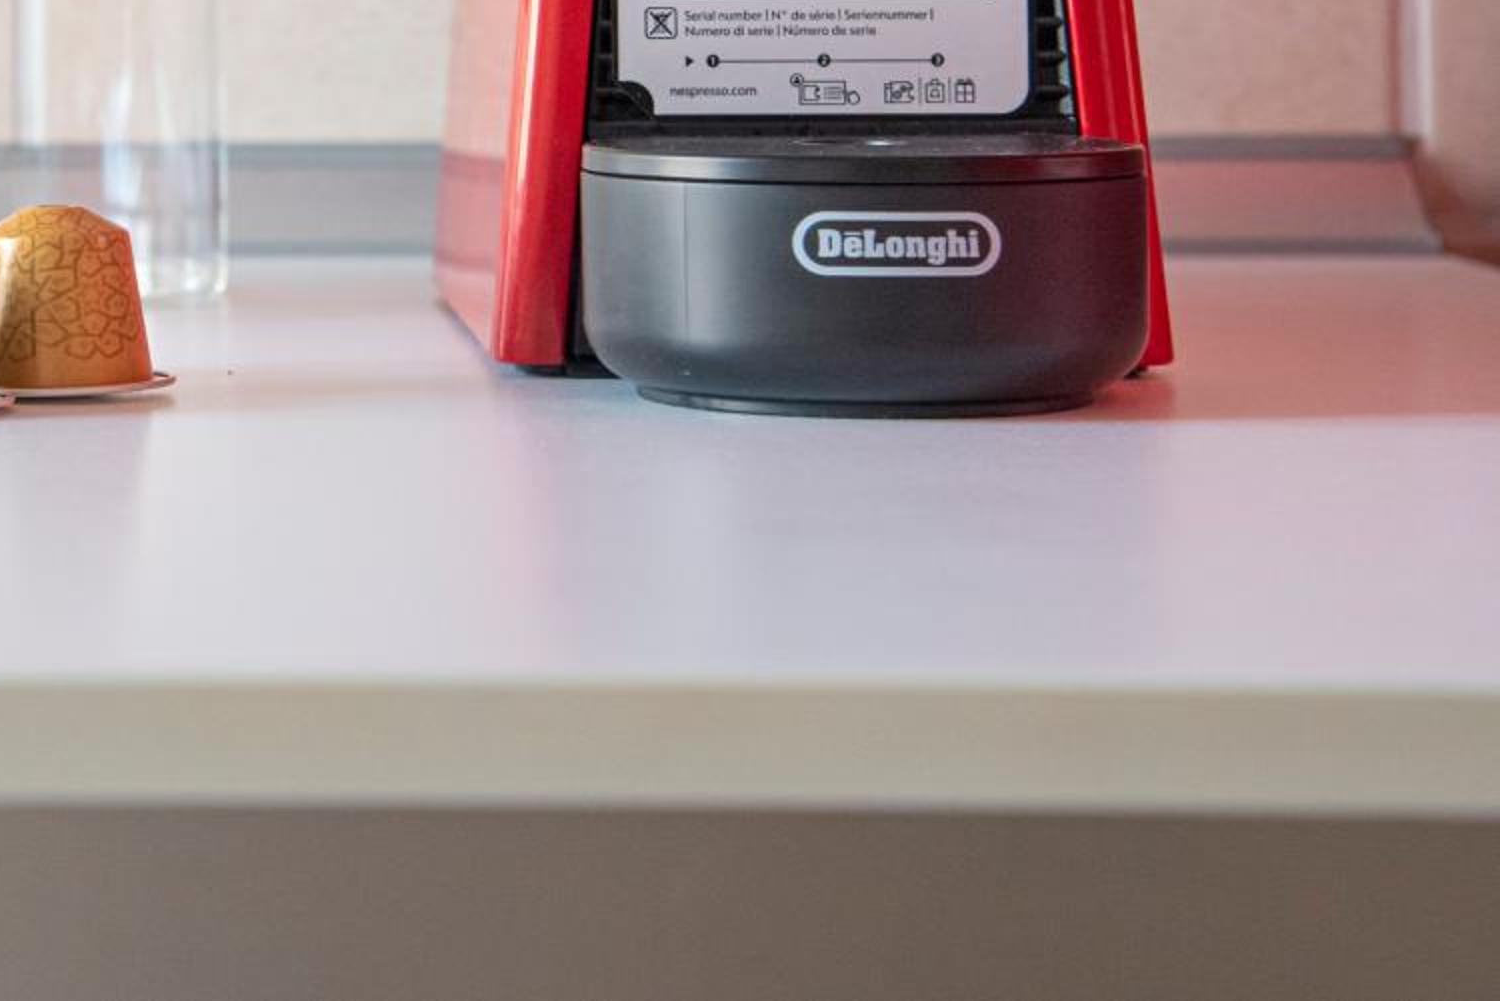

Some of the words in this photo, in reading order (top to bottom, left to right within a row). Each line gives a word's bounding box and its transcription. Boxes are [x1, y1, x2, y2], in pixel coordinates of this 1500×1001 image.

[684, 9, 716, 21] Serial
[718, 9, 762, 21] number
[791, 9, 805, 20] de
[844, 8, 927, 20] Seriennummer
[684, 25, 730, 36] Numero
[733, 25, 745, 36] di
[747, 25, 774, 36] serie
[831, 25, 847, 36] de
[849, 24, 877, 36] serie
[669, 85, 757, 98] nespresso.com
